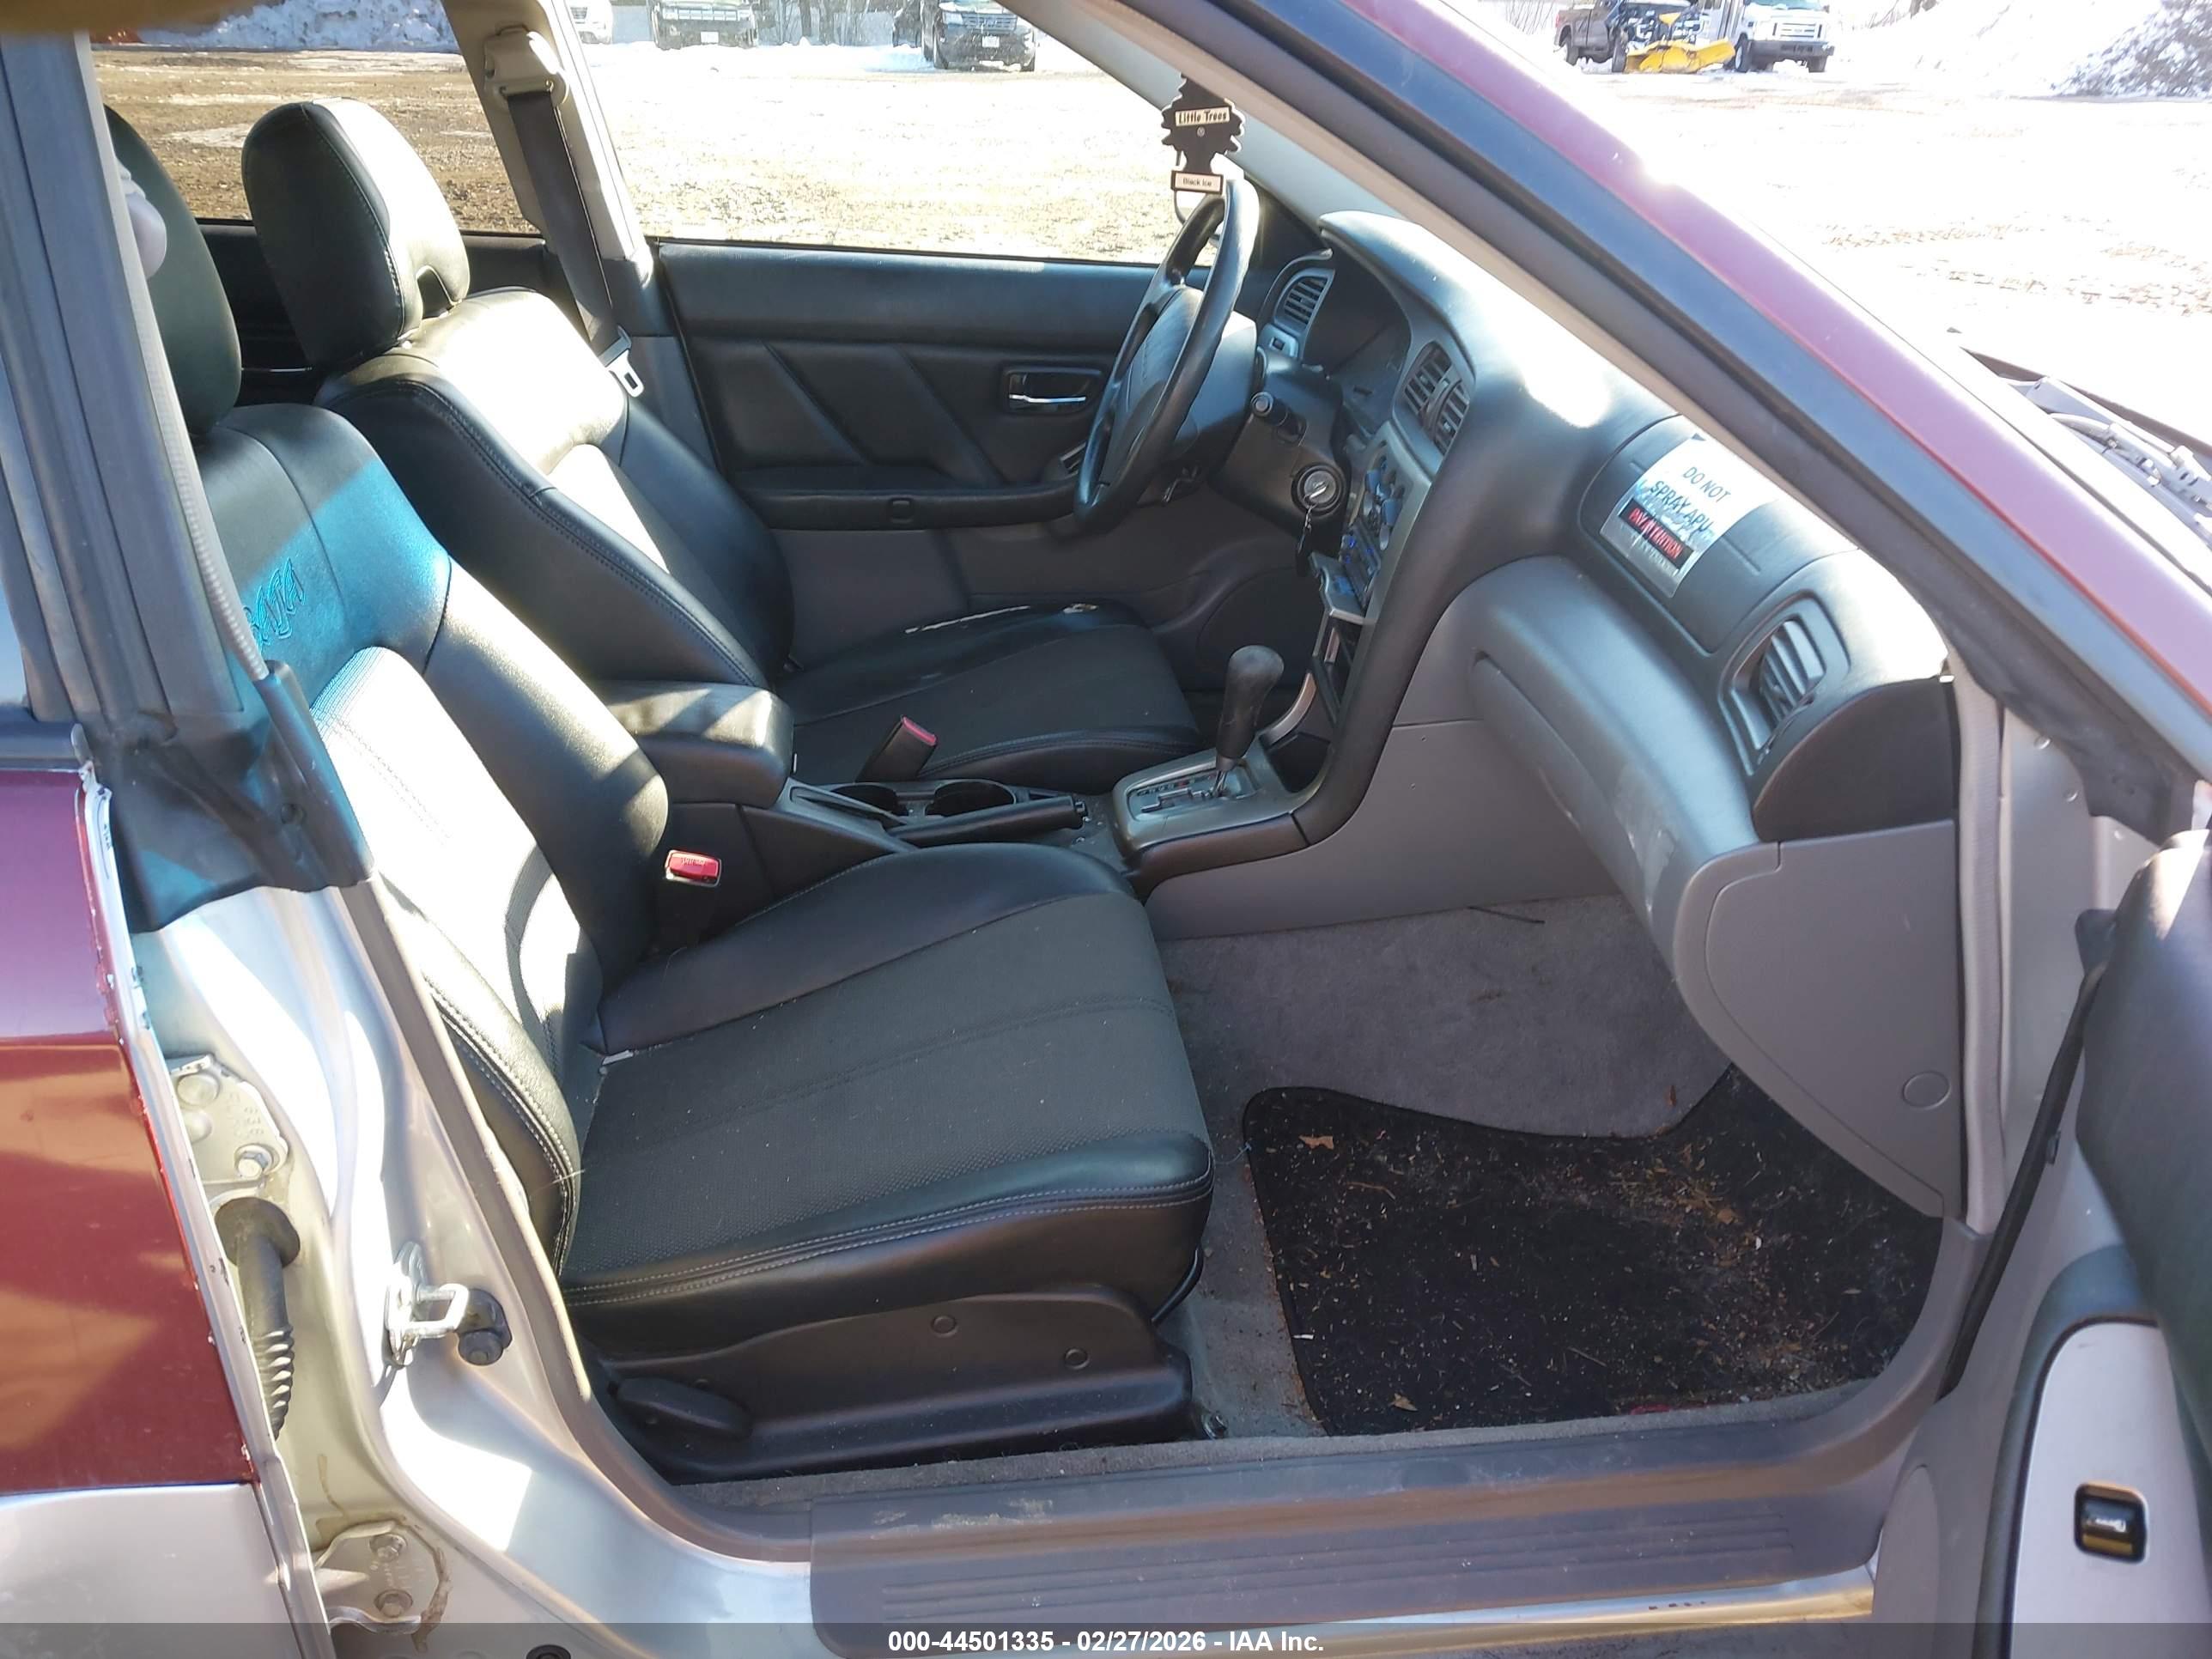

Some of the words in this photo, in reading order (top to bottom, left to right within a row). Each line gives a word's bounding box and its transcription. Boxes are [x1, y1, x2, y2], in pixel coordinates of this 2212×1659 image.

[1178, 112, 1201, 125] Little
[1203, 109, 1227, 122] Trees
[1650, 480, 1692, 514] SPRAY
[1682, 466, 1705, 484] DO
[1699, 479, 1731, 504] NOT
